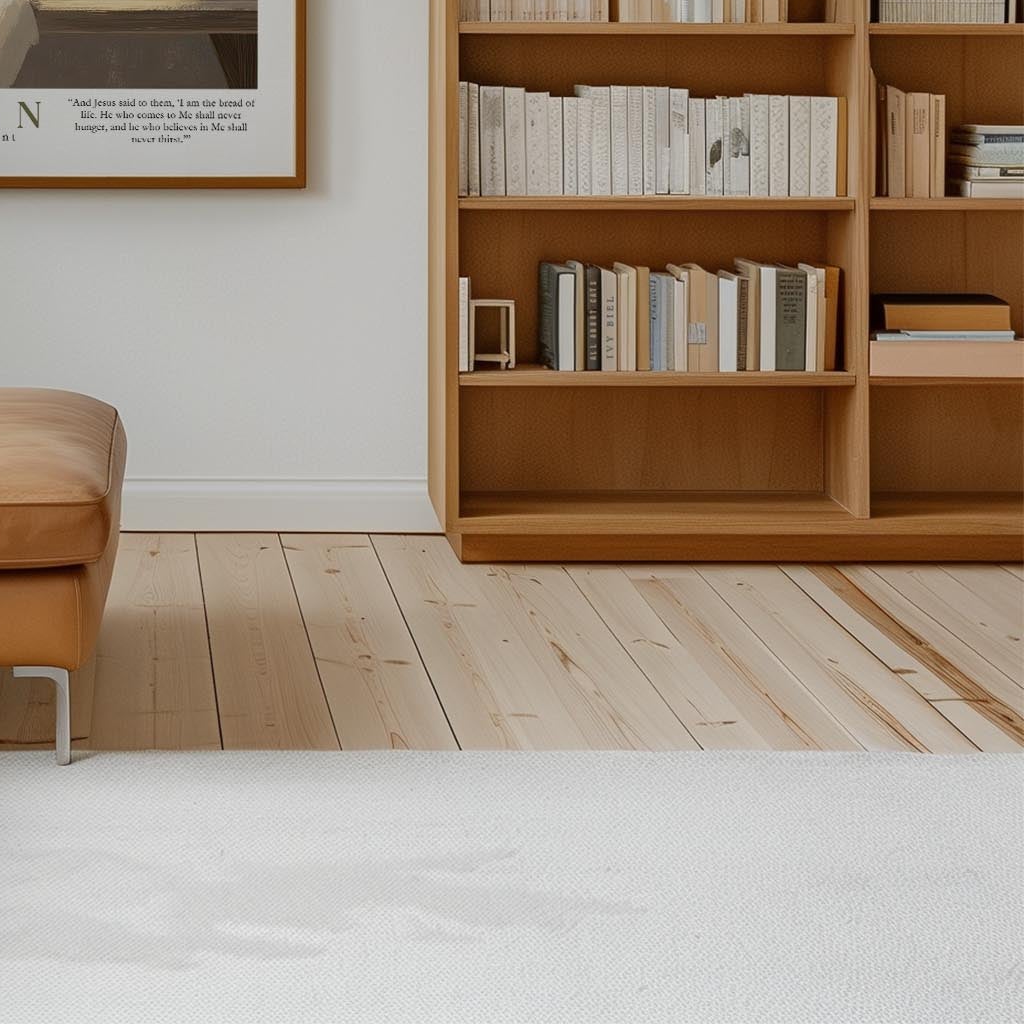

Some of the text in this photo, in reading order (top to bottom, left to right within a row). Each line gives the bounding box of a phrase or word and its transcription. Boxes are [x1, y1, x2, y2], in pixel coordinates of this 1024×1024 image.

[92, 98, 116, 108] Jesus
[118, 98, 136, 107] said
[138, 99, 147, 107] to
[150, 98, 175, 108] them,
[202, 98, 216, 107] the
[219, 98, 243, 107] bread
[245, 98, 255, 107] of
[80, 110, 97, 119] life.
[100, 110, 113, 119] He
[115, 110, 134, 119] who
[167, 111, 176, 119] to
[178, 110, 192, 119] Me
[195, 110, 215, 119] shall
[74, 122, 247, 133] hunger, and he who believes in Me shall
[589, 281, 597, 361] ALL ABOUT CATS
[606, 296, 615, 359] IVY BIEL
